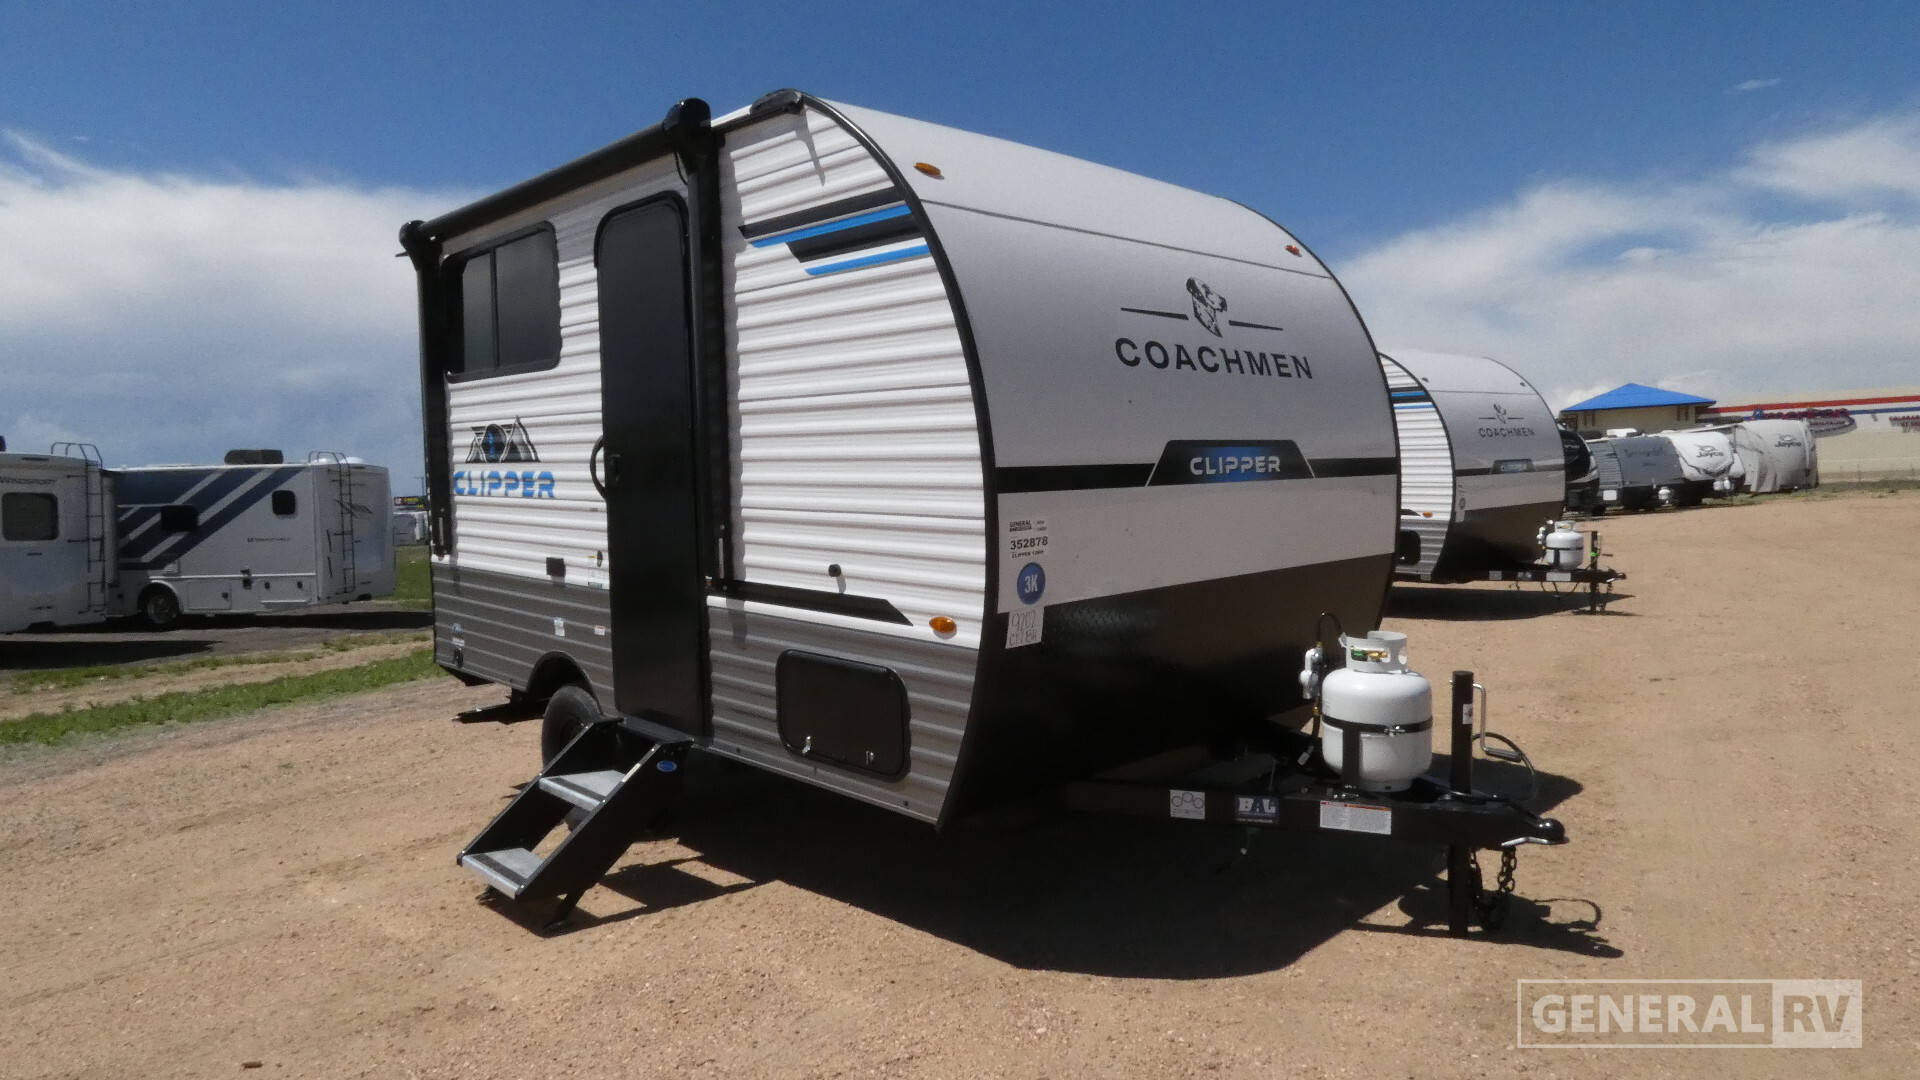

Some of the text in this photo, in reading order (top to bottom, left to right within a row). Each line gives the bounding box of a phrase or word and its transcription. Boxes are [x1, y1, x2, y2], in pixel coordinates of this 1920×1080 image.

[1115, 337, 1313, 380] COACHMEN
[1478, 427, 1535, 438] COACHMEN
[1774, 440, 1802, 448] Jayco
[1696, 451, 1725, 459] Jayco
[1189, 456, 1281, 476] CLIPPER
[453, 470, 556, 499] CLIPPER
[1010, 536, 1048, 550] 352878
[1024, 574, 1038, 594] 3K
